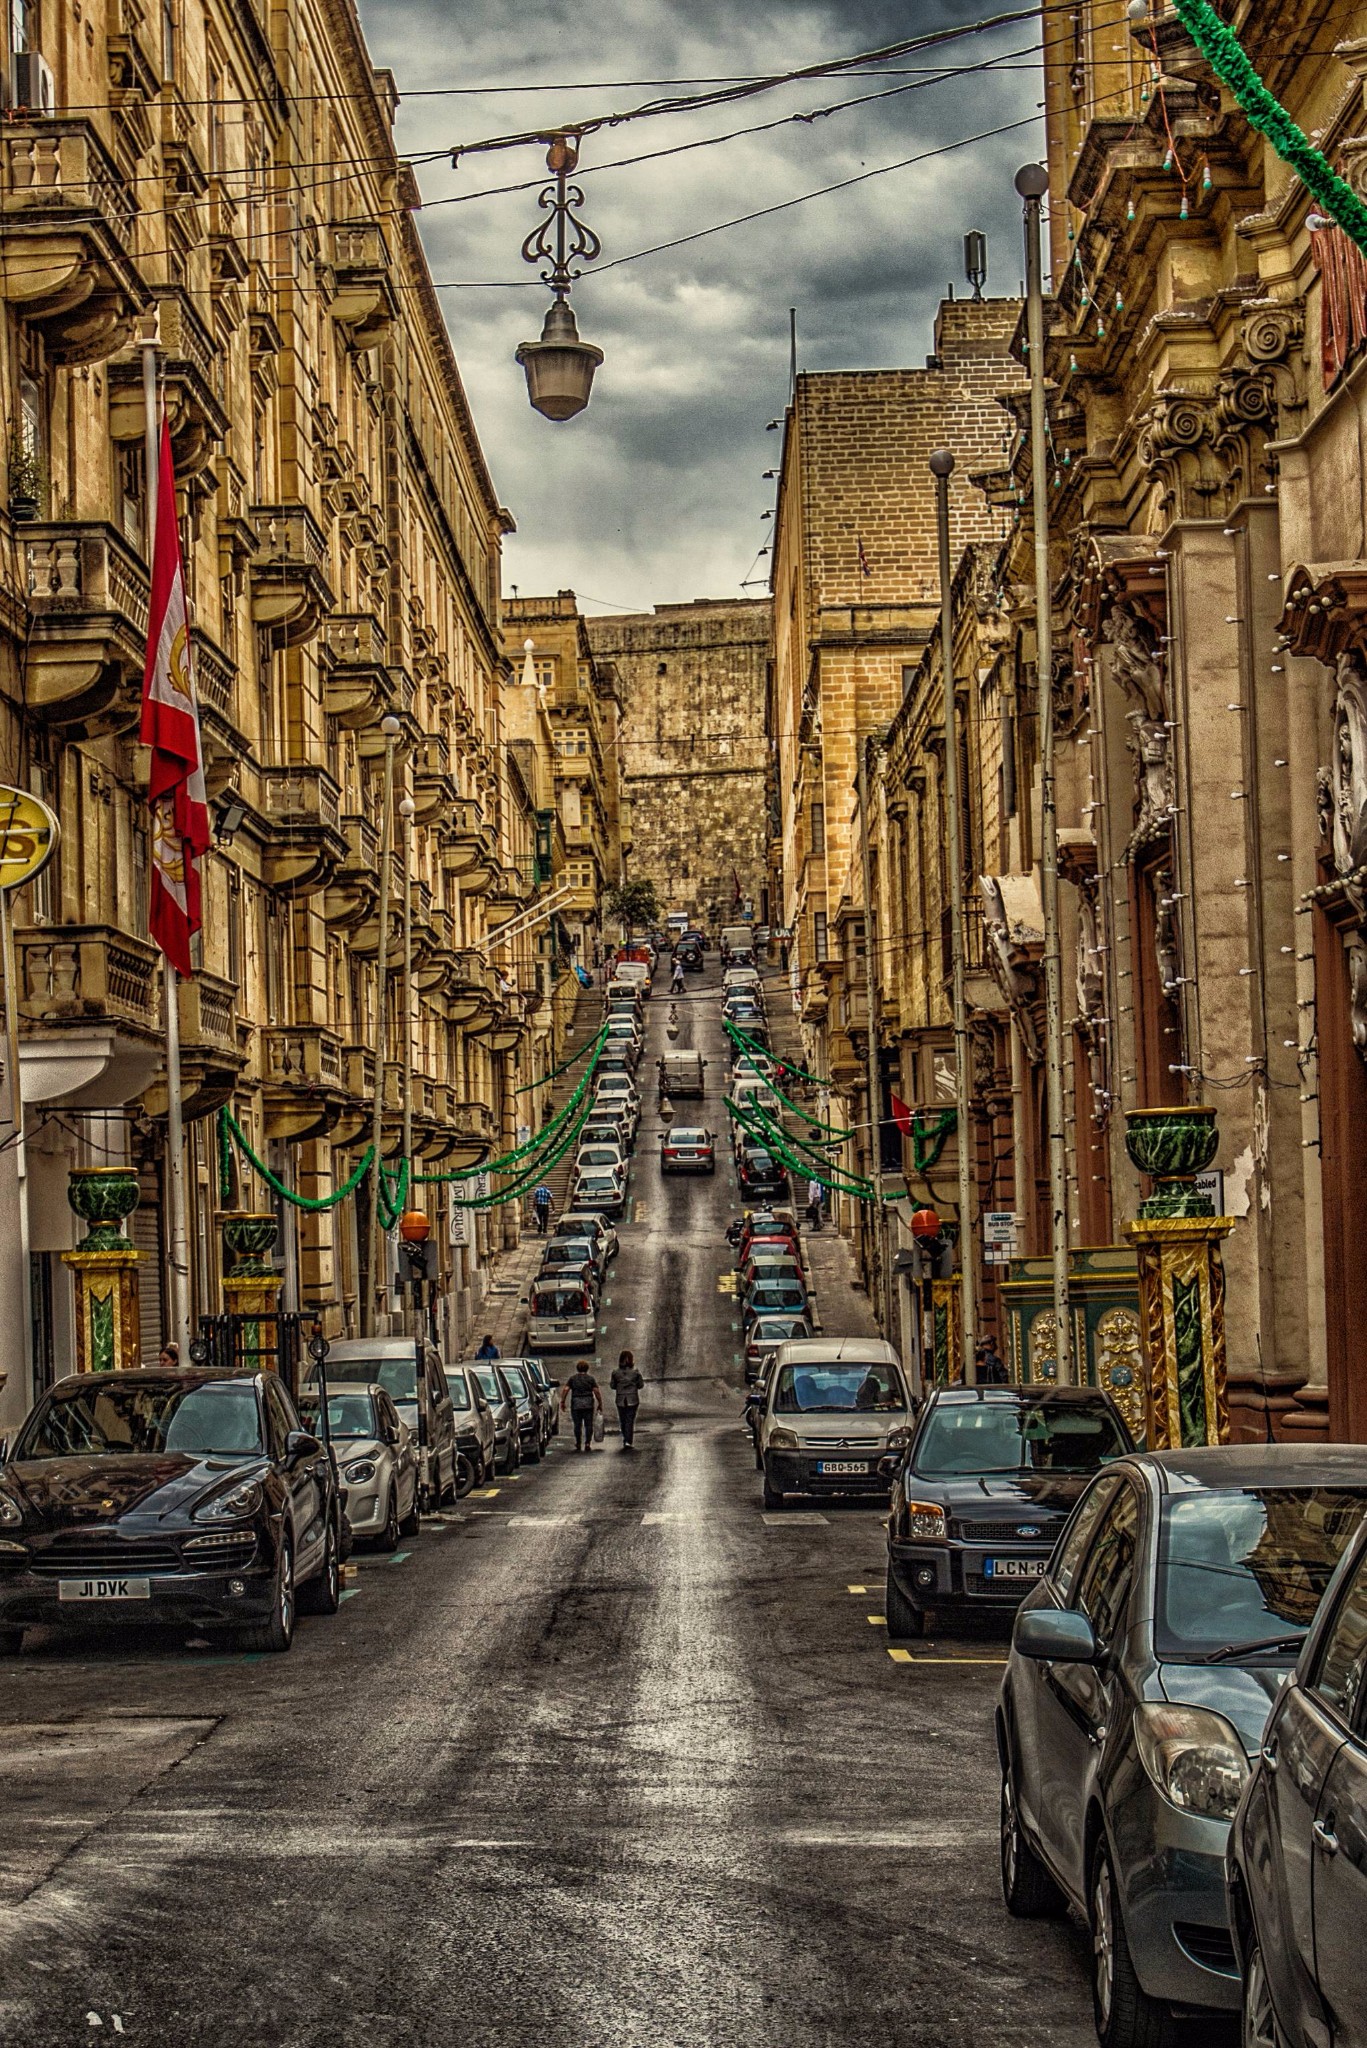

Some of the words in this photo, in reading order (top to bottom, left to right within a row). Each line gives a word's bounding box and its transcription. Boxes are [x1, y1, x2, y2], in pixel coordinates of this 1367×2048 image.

[1194, 1177, 1217, 1190] sabled
[451, 1185, 466, 1241] IMERIUM
[97, 1580, 129, 1597] DVK
